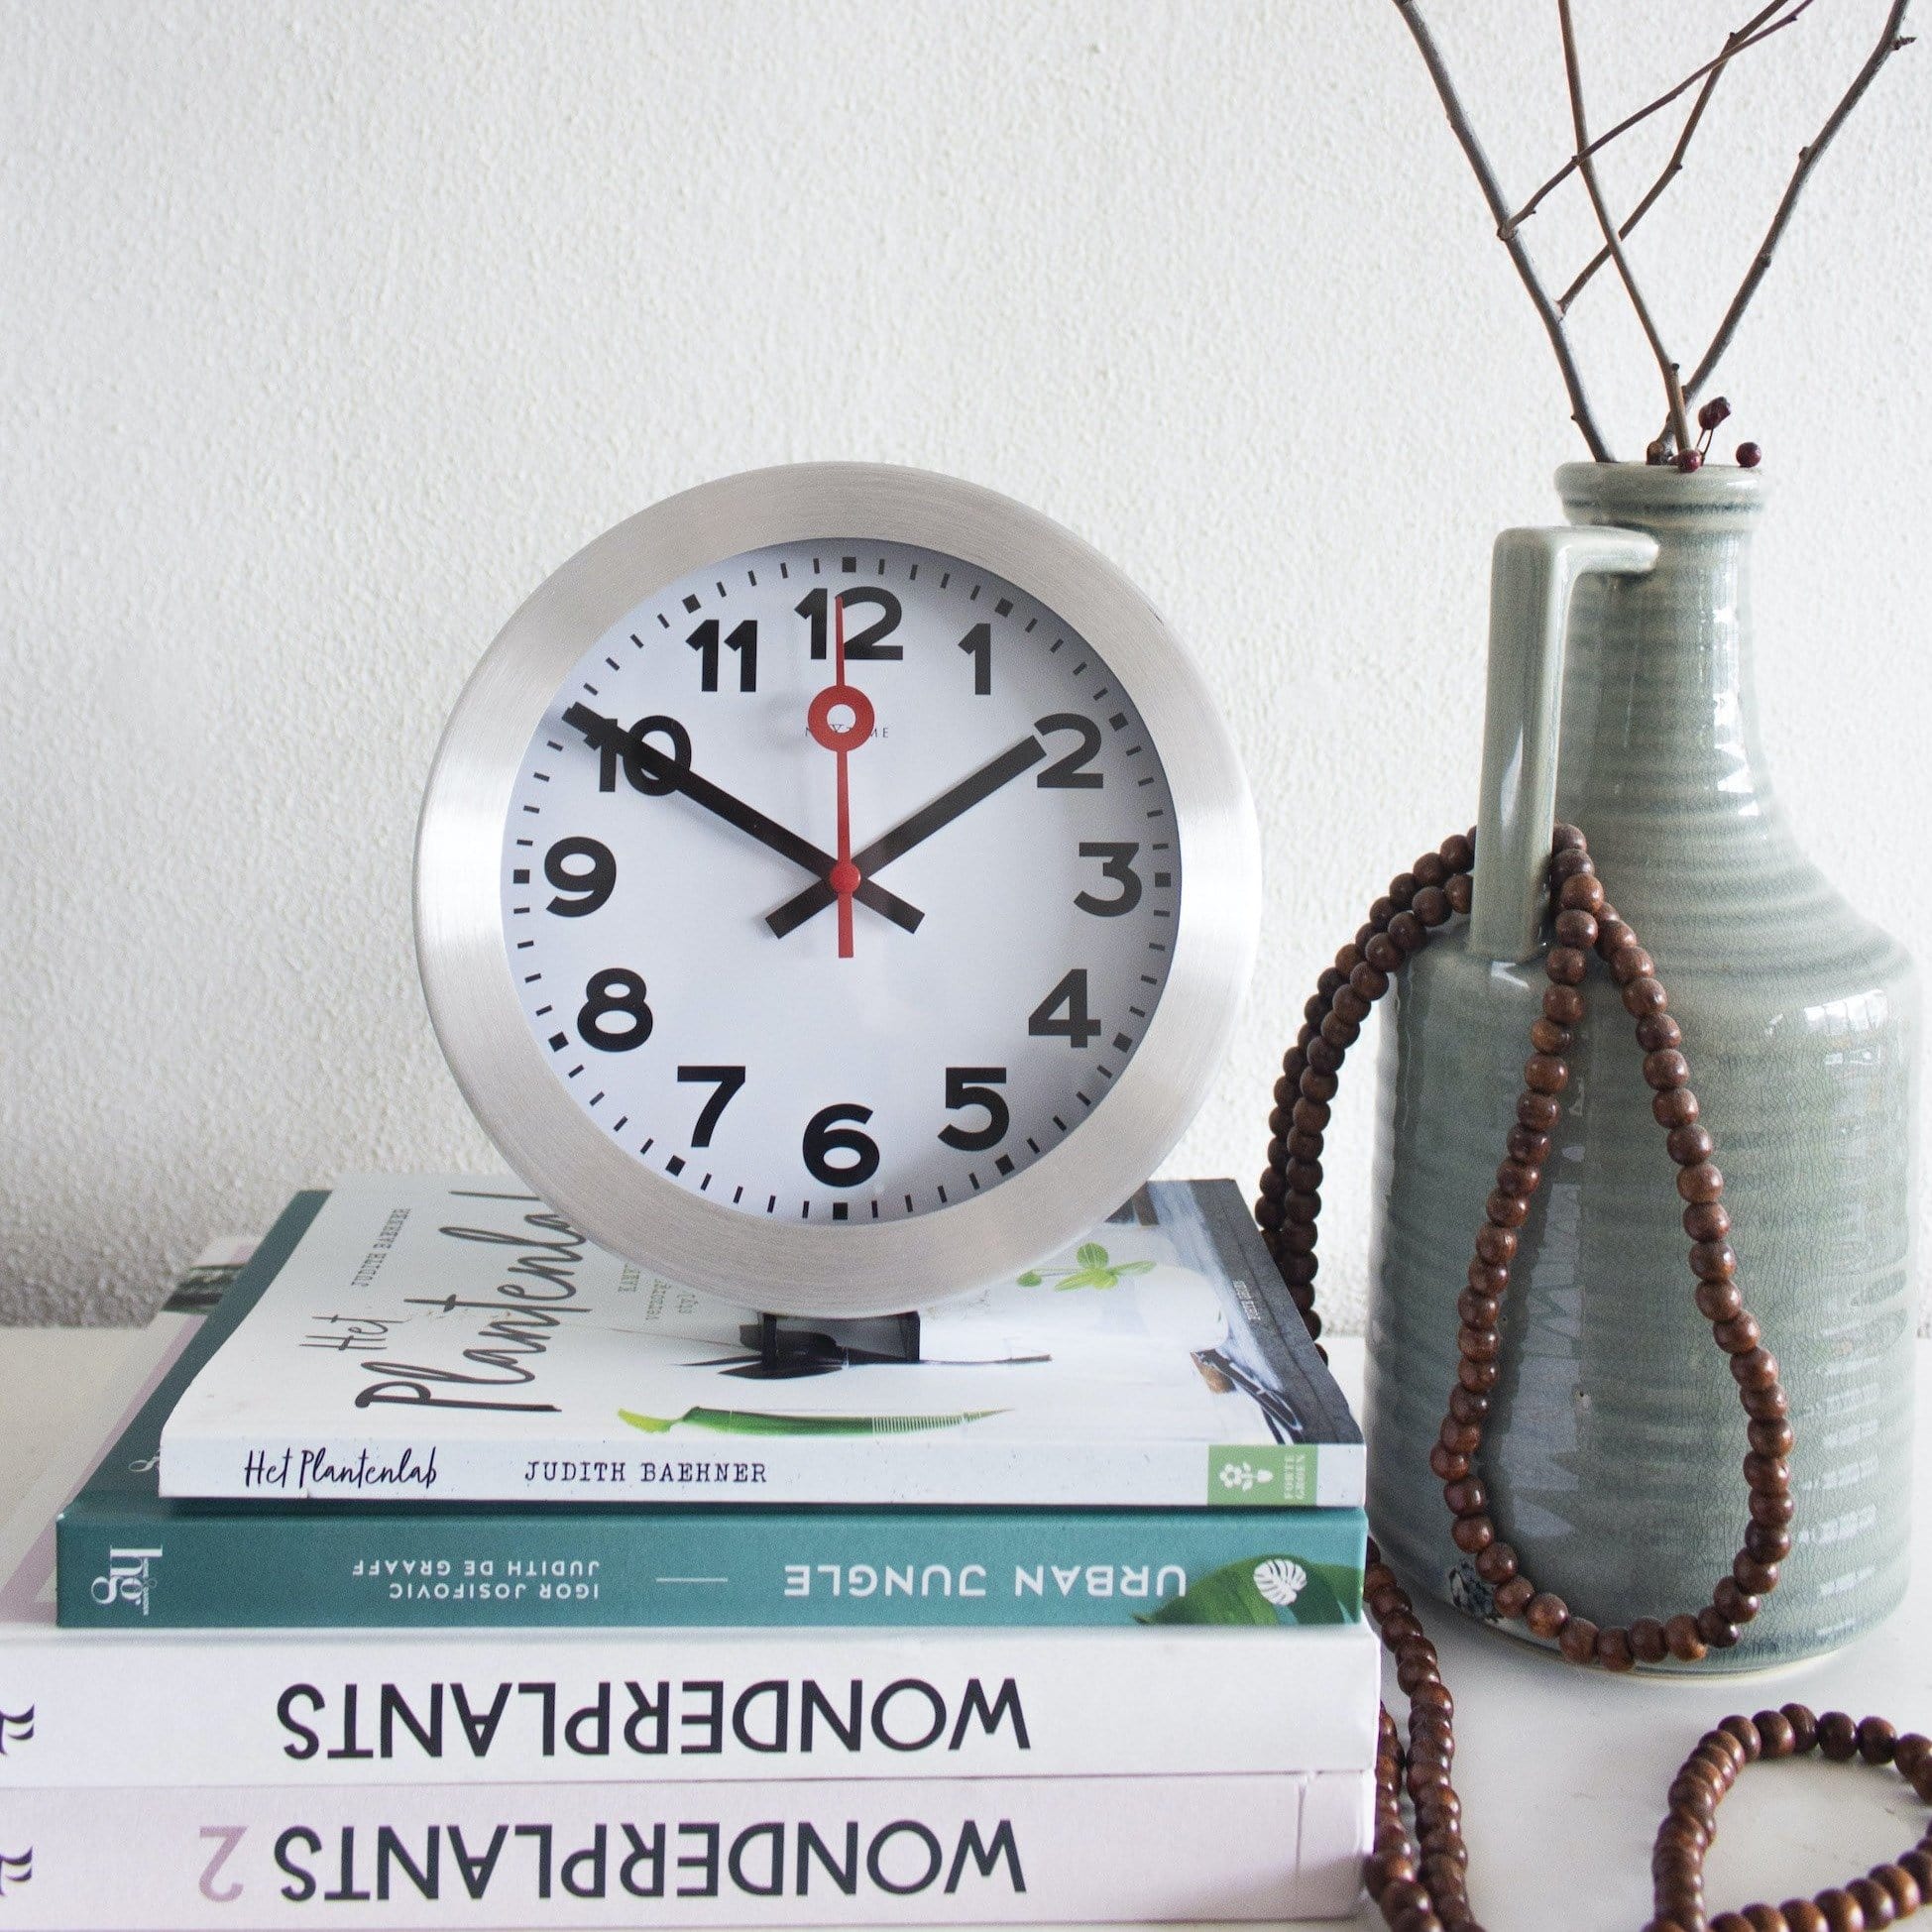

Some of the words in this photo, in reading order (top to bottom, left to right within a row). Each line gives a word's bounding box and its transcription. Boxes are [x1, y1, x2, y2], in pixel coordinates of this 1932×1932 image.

[685, 620, 757, 692] 11
[794, 586, 903, 661] 12
[958, 623, 991, 695] 1
[584, 716, 693, 796] 10
[1036, 713, 1103, 789] 2
[544, 837, 617, 918] 9
[1074, 842, 1143, 917] 3
[577, 967, 654, 1053] 8
[1028, 968, 1101, 1049] 4
[677, 1066, 746, 1148] 7
[937, 1067, 1010, 1152] 5
[802, 1103, 880, 1189] 6
[298, 1313, 404, 1351] Het
[244, 1447, 293, 1489] Het
[298, 1446, 437, 1490] Plantenlab
[524, 1462, 625, 1482] JUDITH
[641, 1462, 767, 1483] BAEHNER
[352, 1559, 451, 1576] GRAAFF
[389, 1582, 525, 1599] JOSIFOVIC
[464, 1560, 494, 1576] DE
[508, 1559, 600, 1577] JUDITH
[539, 1582, 600, 1600] IGOR
[783, 1564, 987, 1597] JUNGLE
[1014, 1564, 1188, 1597] URBAN
[277, 1678, 1031, 1761] WONDERPLANTS
[198, 1825, 248, 1903] 2
[274, 1820, 1027, 1903] WONDERPLANTS
